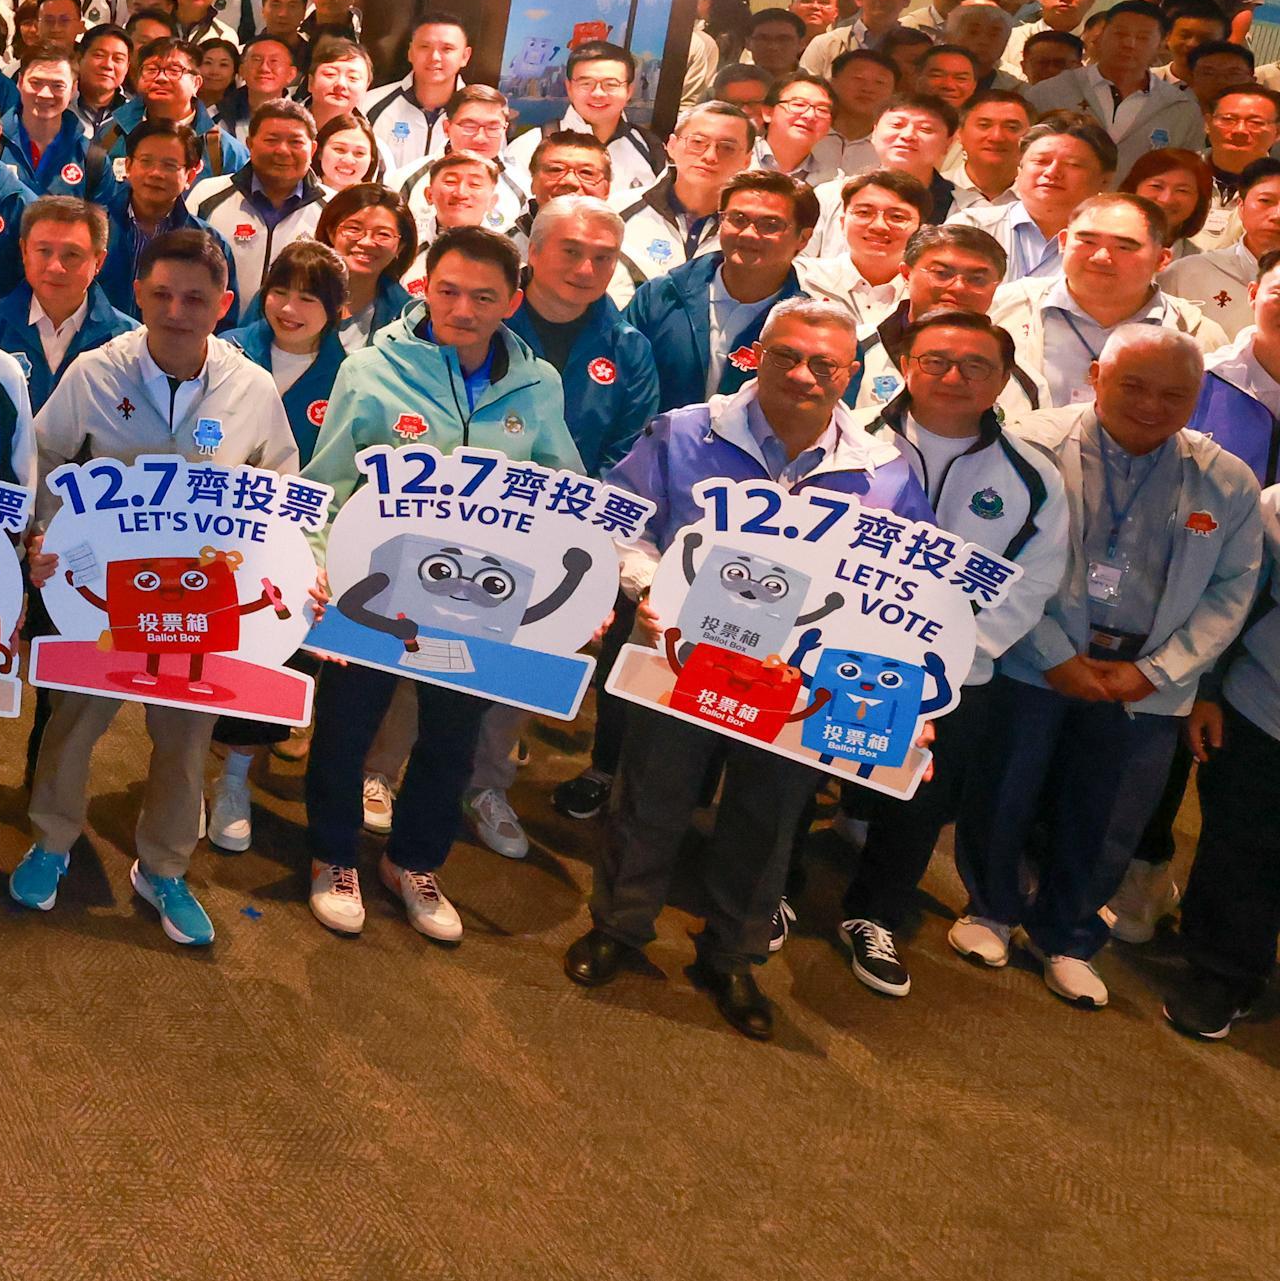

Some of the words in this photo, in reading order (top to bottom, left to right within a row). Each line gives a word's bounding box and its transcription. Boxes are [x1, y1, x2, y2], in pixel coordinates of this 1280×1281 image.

[54, 462, 178, 515] 12.7
[186, 468, 328, 528] 齊投票
[364, 452, 498, 497] 12.7
[502, 467, 649, 538] 齊投票
[118, 513, 188, 534] LET'S
[195, 515, 267, 543] VOTE
[379, 499, 452, 520] LET'S
[457, 501, 534, 533] VOTE
[702, 486, 850, 543] 12.7
[849, 513, 1014, 603] 齊投票
[835, 559, 920, 602] LET'S
[138, 612, 208, 633] 投票箱
[700, 615, 761, 647] 投票箱
[860, 595, 943, 644] VOTE
[146, 633, 176, 643] Ballot
[178, 633, 200, 643] Box
[703, 632, 727, 650] Ballot
[727, 640, 748, 654] Box
[697, 688, 760, 723] 投票箱
[699, 706, 723, 724] Ballot
[722, 714, 745, 728] Box
[822, 723, 890, 753] 投票箱
[827, 741, 856, 756] Ballot
[858, 747, 878, 759] Box
